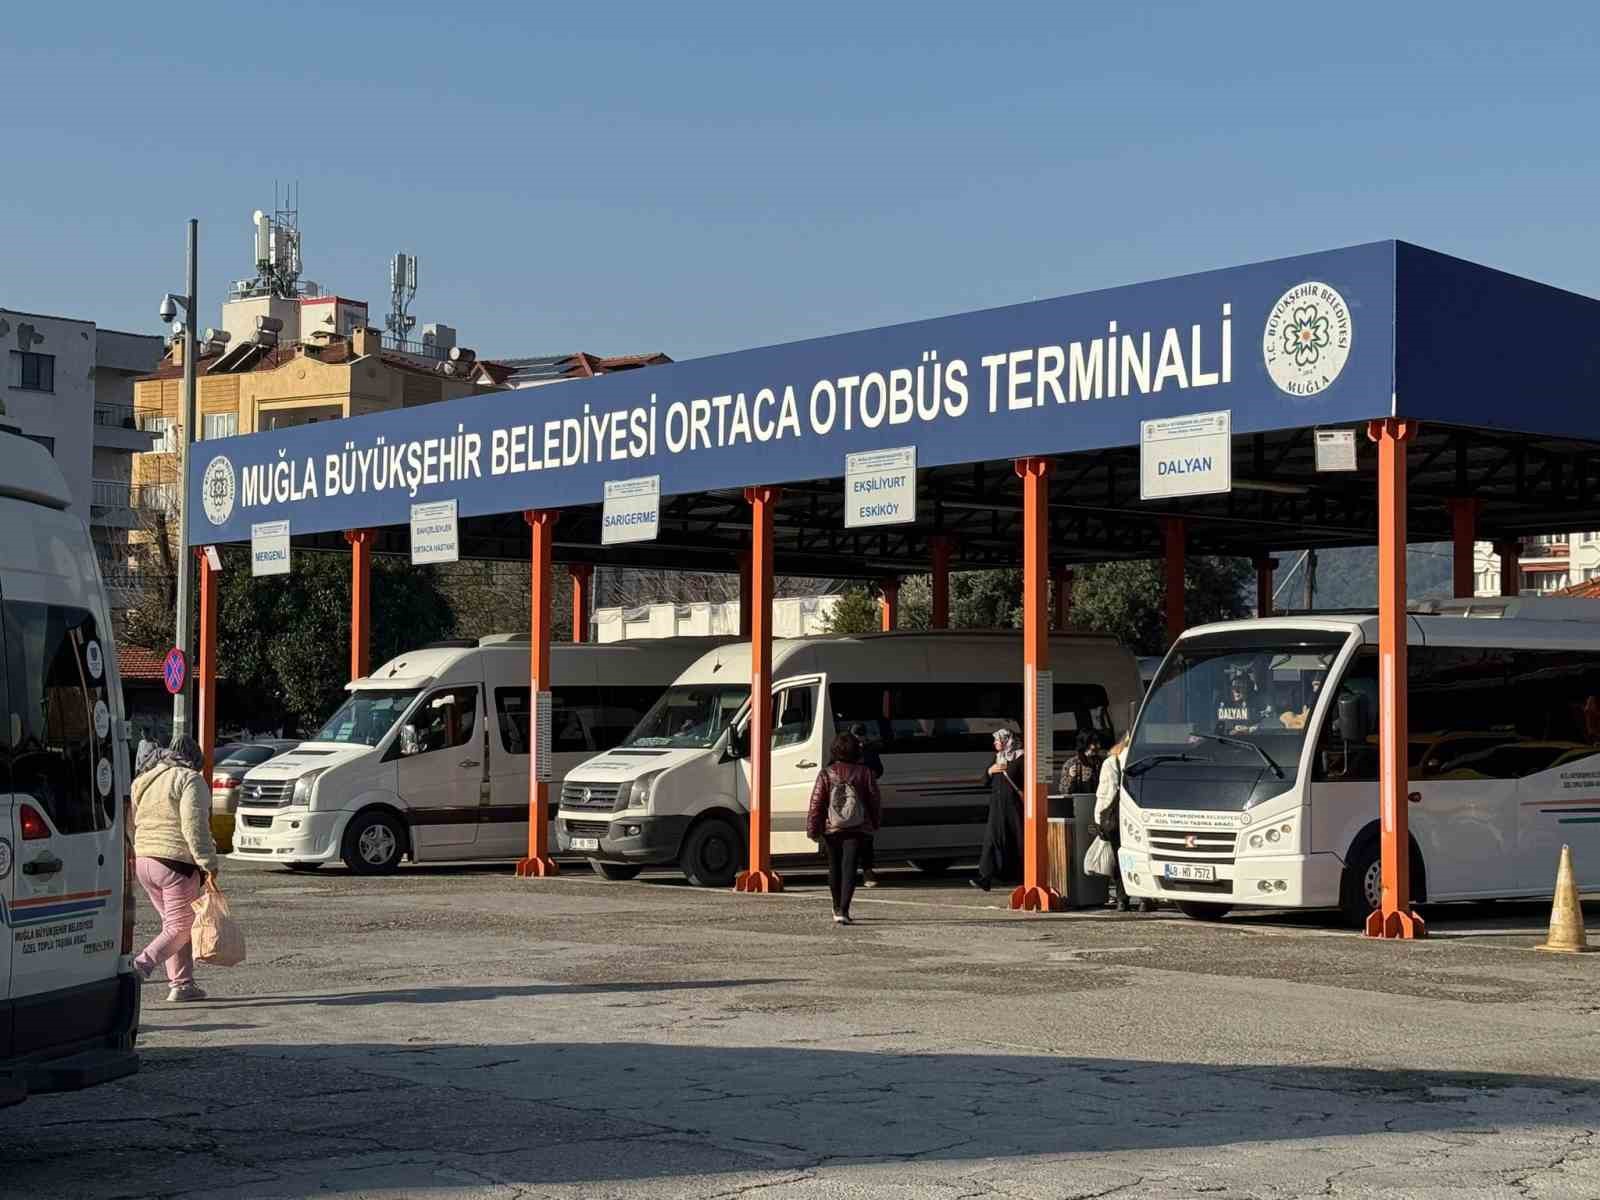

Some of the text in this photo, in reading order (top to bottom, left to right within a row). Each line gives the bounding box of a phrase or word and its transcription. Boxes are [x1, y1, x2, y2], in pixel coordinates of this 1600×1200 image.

[1287, 375, 1330, 394] MUĞLA
[241, 448, 318, 508] MUĞLA
[324, 423, 482, 498] BÜYÜKŞEHİR
[491, 393, 657, 476] BELEDİYESİ
[665, 385, 801, 454] ORTACA
[809, 349, 969, 435] OTOBÜS
[981, 302, 1232, 413] TERMİNALİ
[1158, 457, 1212, 476] DALYAN
[854, 475, 906, 494] EKŞİLİYURT
[860, 502, 899, 518] ESKİKÖY
[1219, 707, 1248, 720] DALYAN
